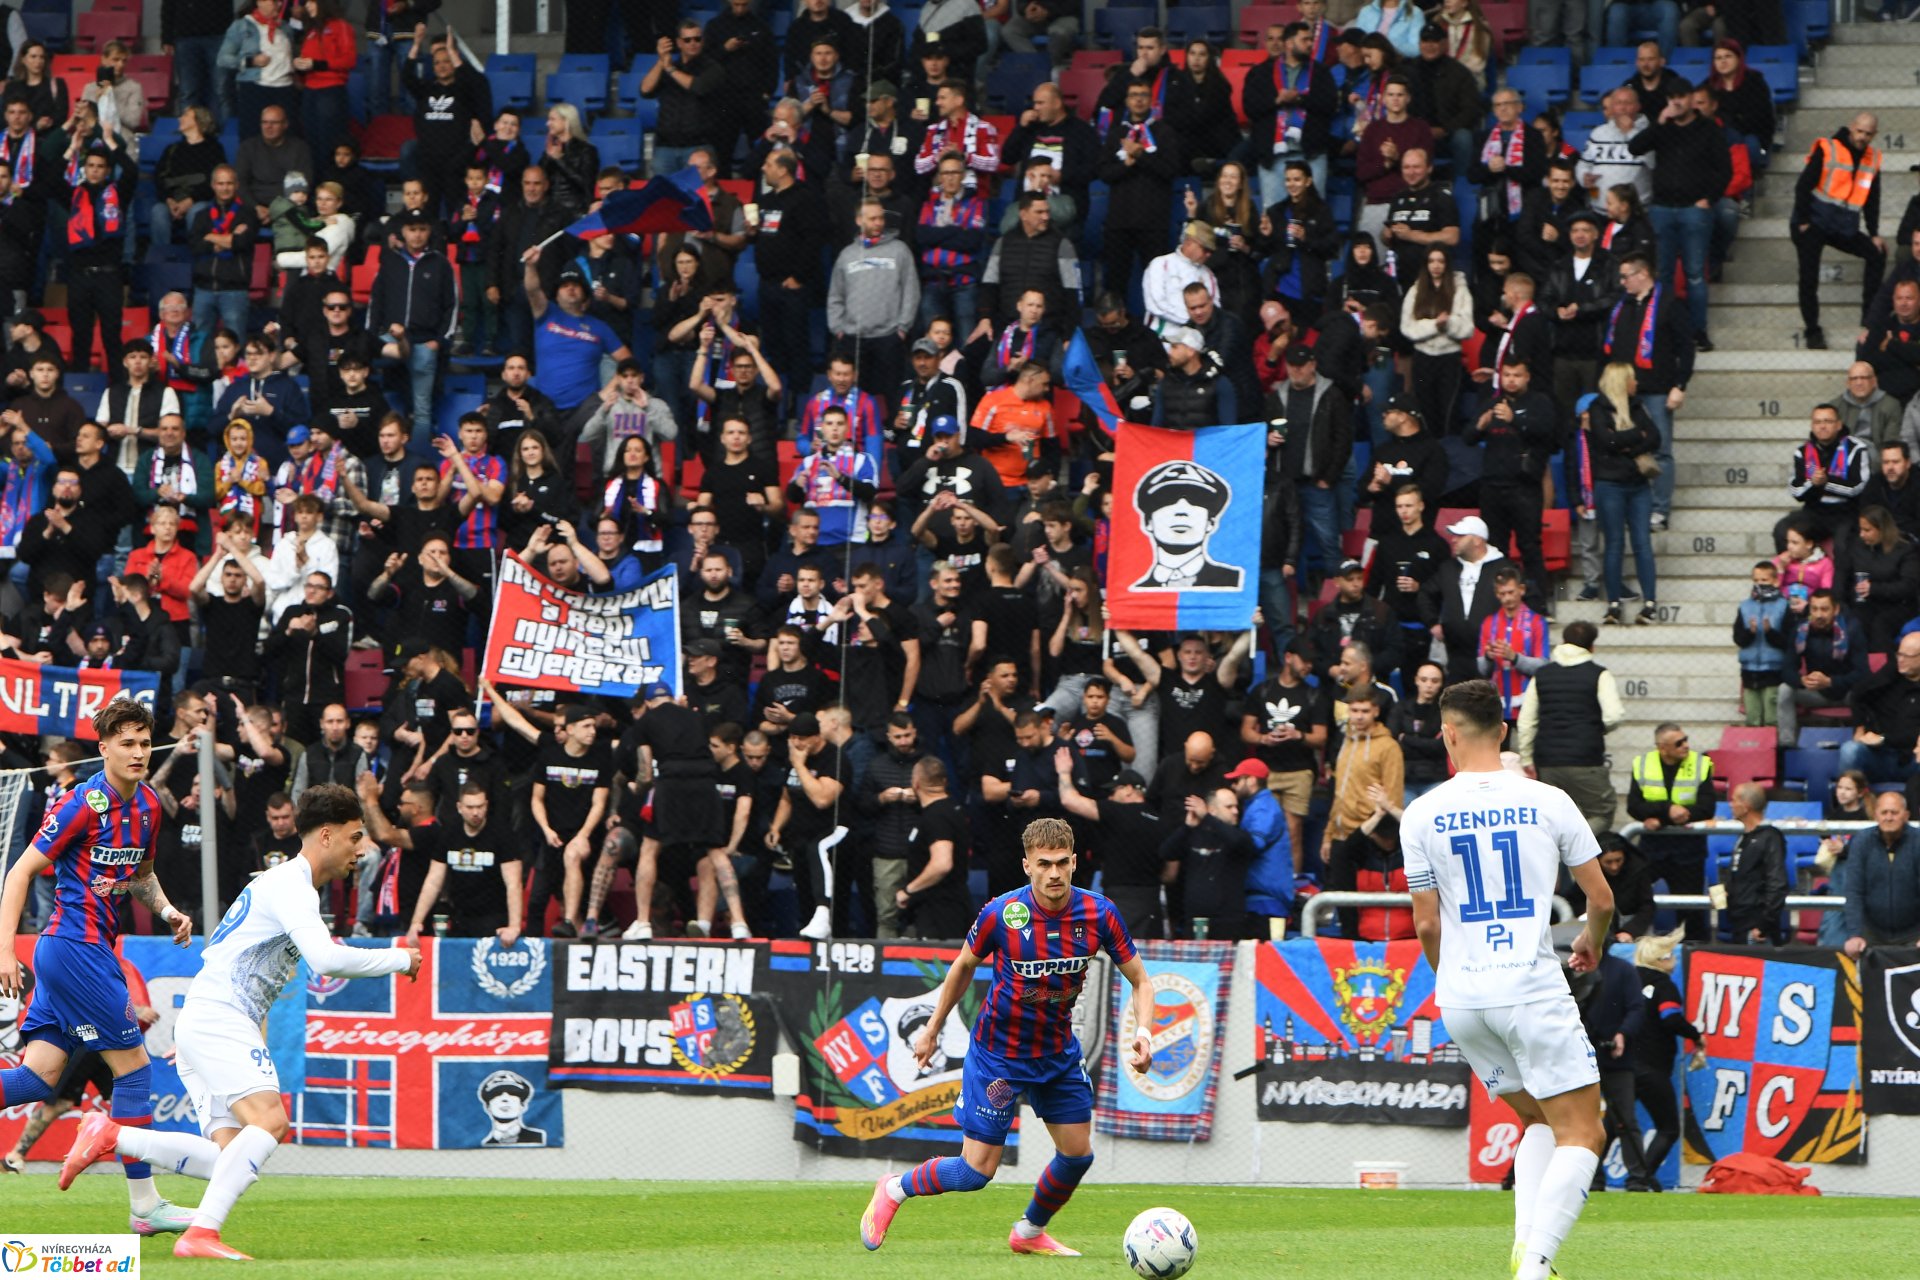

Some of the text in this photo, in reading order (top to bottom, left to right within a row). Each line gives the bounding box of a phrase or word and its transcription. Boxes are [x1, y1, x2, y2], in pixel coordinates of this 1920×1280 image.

[1884, 134, 1904, 149] 14
[1758, 401, 1779, 416] 10
[1726, 468, 1748, 484] 09
[1693, 537, 1716, 552] 08
[1658, 606, 1681, 622] 07
[1626, 681, 1649, 697] 06
[1434, 807, 1538, 833] SZENDREI
[1450, 830, 1535, 923] 11
[488, 951, 529, 967] 1928
[567, 944, 755, 995] EASTERN
[815, 942, 876, 973] 1928
[696, 1003, 710, 1025] S
[1692, 972, 1815, 1045] NY S
[564, 1018, 673, 1065] BOYS
[822, 1009, 886, 1073] NY S
[862, 1068, 885, 1104] F
[1871, 1066, 1920, 1084] NYÍR
[1703, 1068, 1794, 1138] F C
